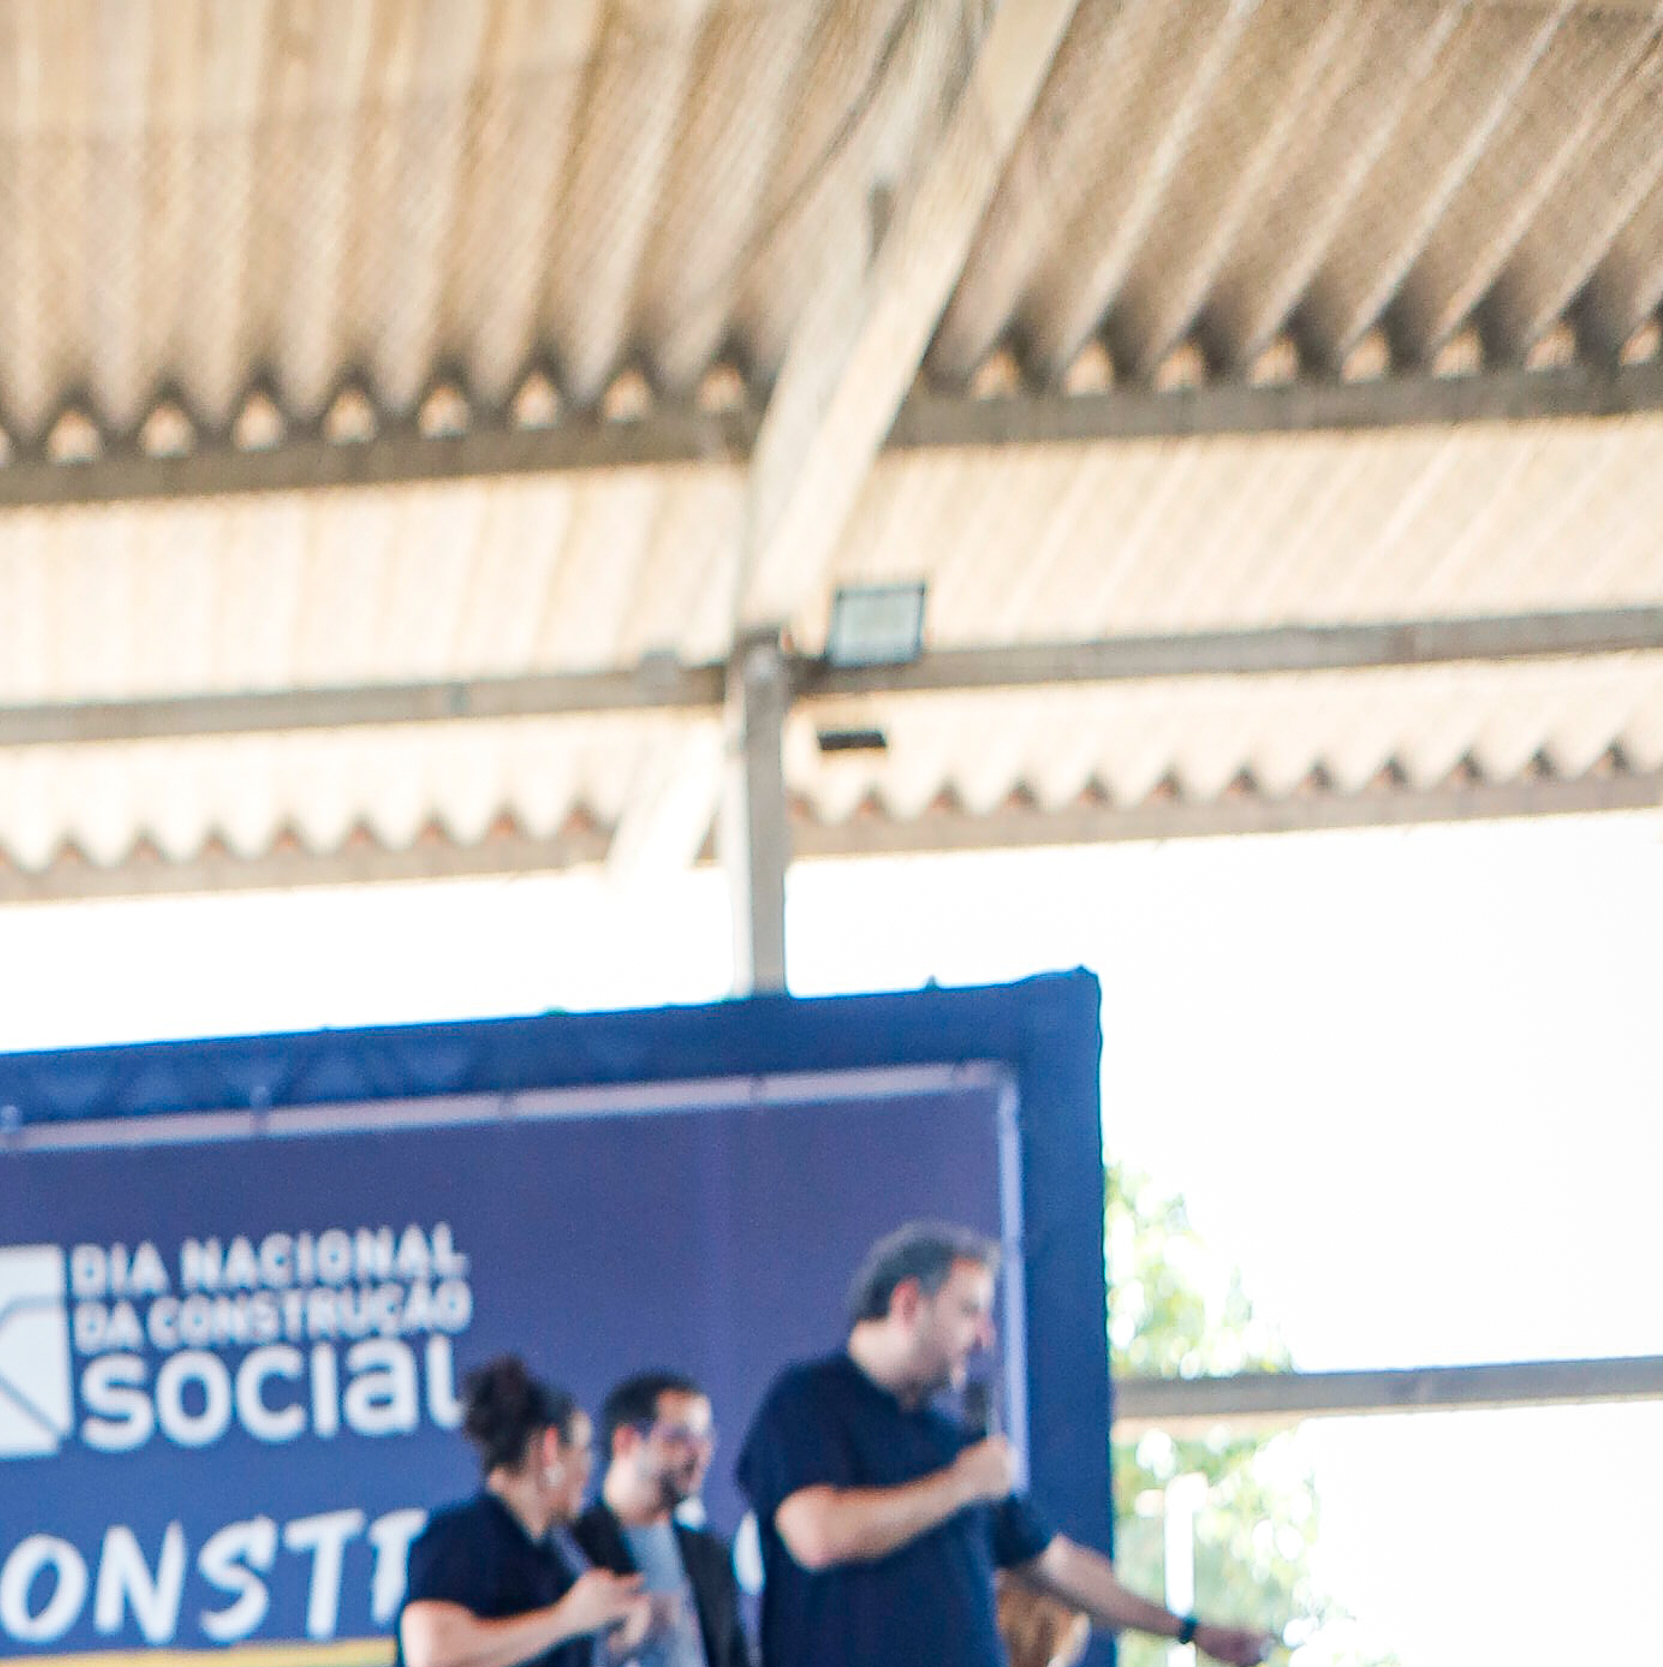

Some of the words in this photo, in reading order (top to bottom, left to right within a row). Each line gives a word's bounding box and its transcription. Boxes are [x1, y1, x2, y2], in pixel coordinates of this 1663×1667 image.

[70, 1240, 170, 1299] DIA
[181, 1221, 470, 1292] NACIONAL
[73, 1300, 144, 1356] DA
[148, 1273, 474, 1353] CONSTRUÇÃO
